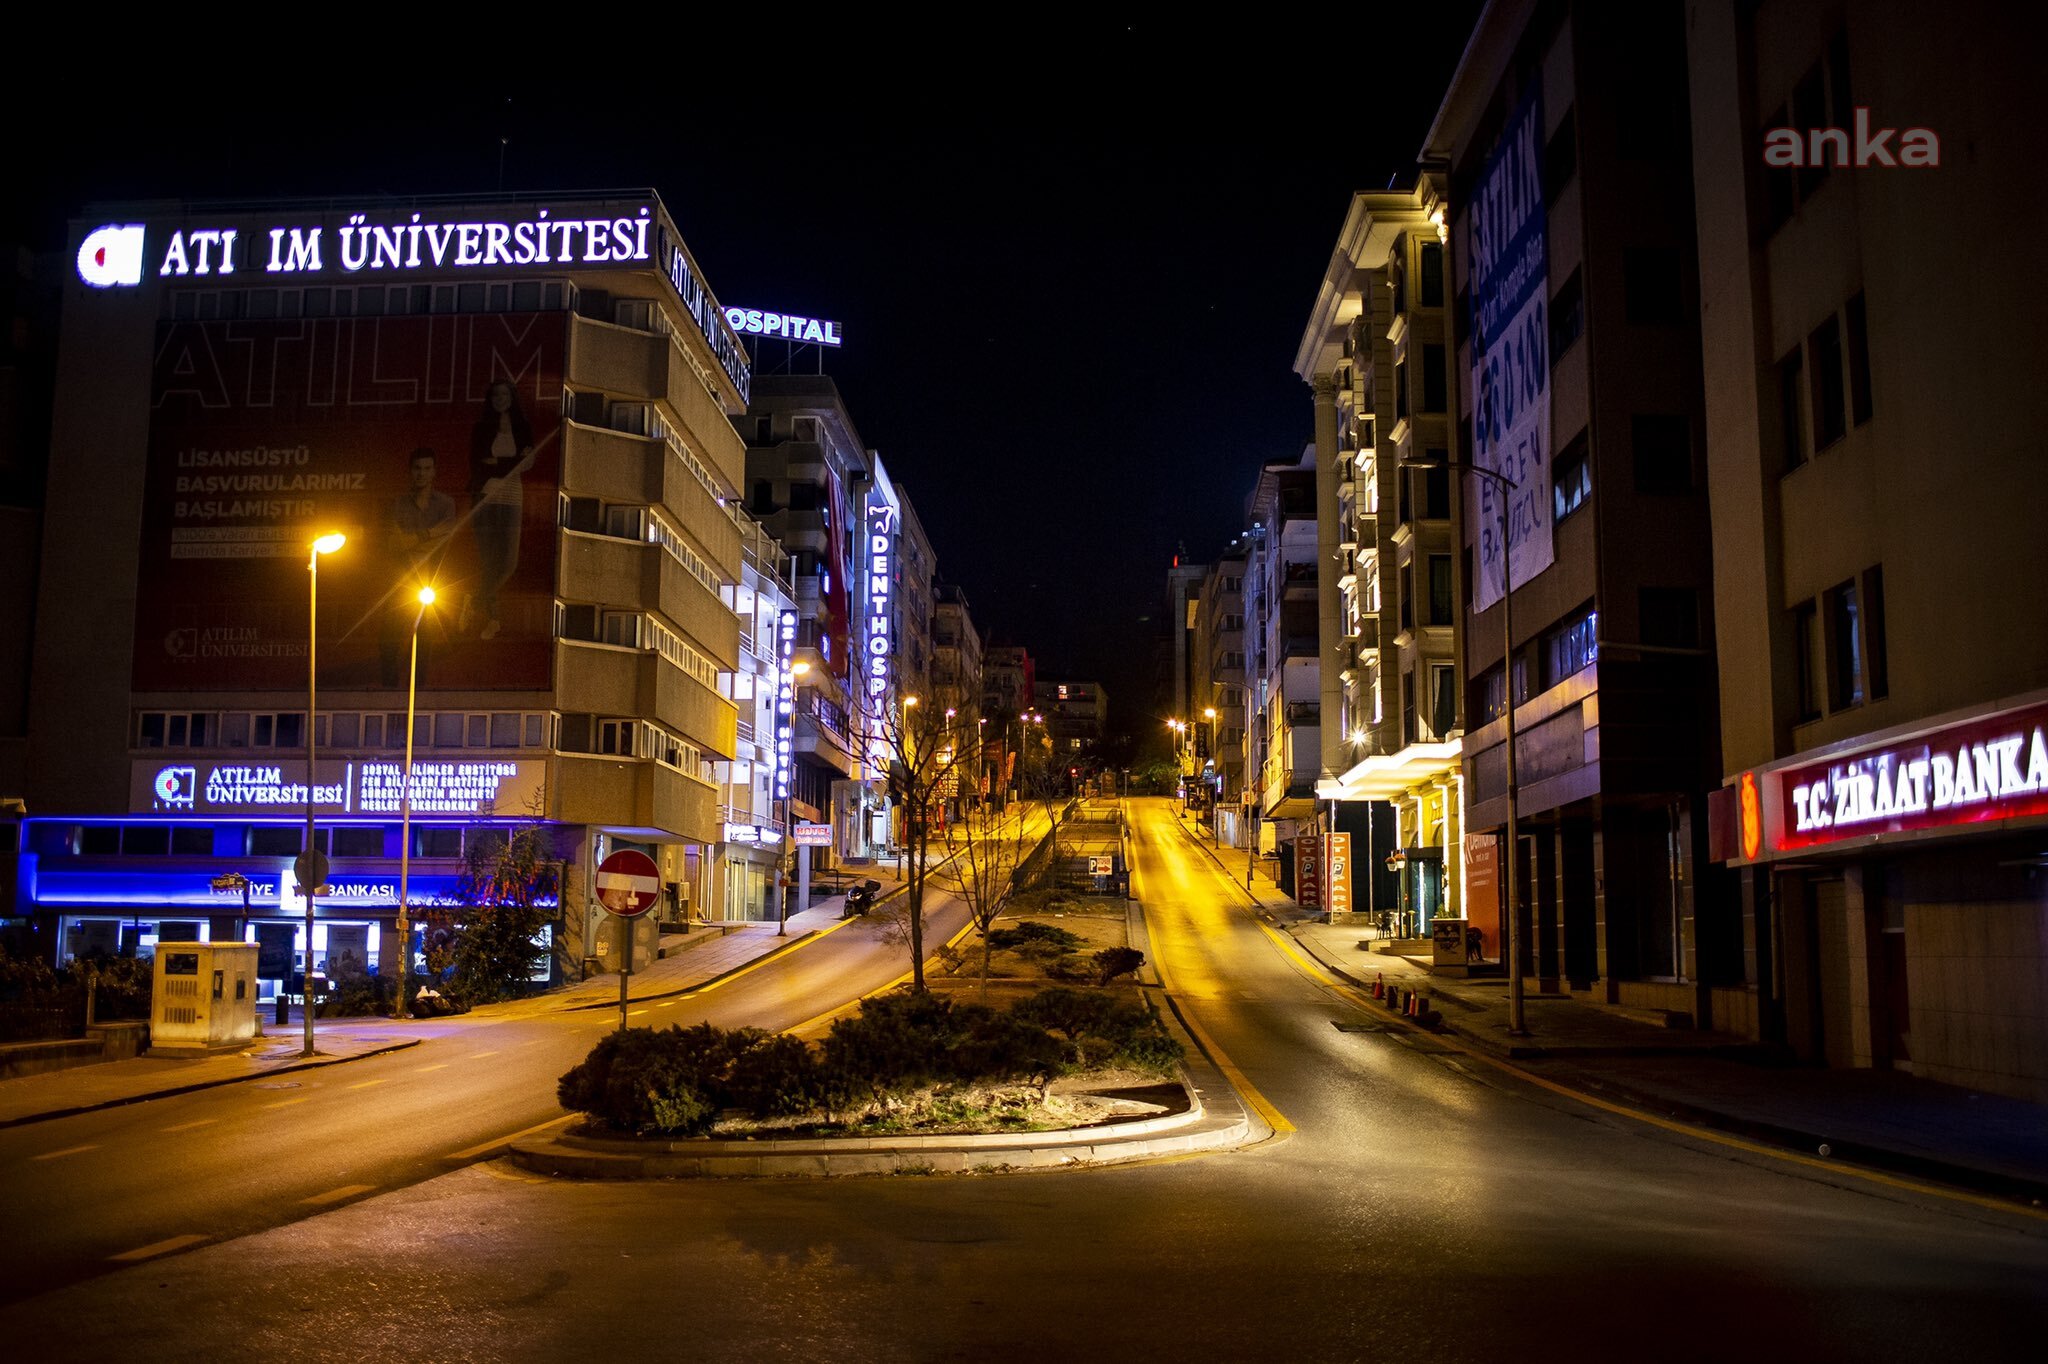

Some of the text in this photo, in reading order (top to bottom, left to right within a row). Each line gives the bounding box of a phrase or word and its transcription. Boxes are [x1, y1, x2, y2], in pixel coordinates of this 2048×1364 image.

[1472, 99, 1541, 297] SATILIK
[338, 207, 651, 272] ÜNİVERSİTESİ
[671, 246, 703, 328] ATILIM
[721, 306, 840, 345] OSPITAL
[152, 313, 563, 409] ATILIM
[177, 445, 311, 468] LİSANSÜSTÜ
[175, 473, 367, 495] BAŞVURULARIMIZ
[174, 500, 316, 521] BAŞLAMIŞTIR
[202, 627, 257, 641] ATILIM
[201, 642, 309, 657] ÜNİVERSİTESİ
[208, 766, 282, 784] ATILIM
[362, 762, 517, 776] SOSYAL İLİMLER ENSTİTÜSÜ
[1793, 726, 2048, 832] T.C. ZİRAAT BANKA
[362, 775, 381, 788] FEN
[441, 774, 499, 788] ENSTİTÜSÜ
[361, 786, 405, 799] SÜREKLİ
[449, 786, 495, 799] MERKEZİ
[361, 798, 478, 811] MESLEK ÜKSEKOKULU
